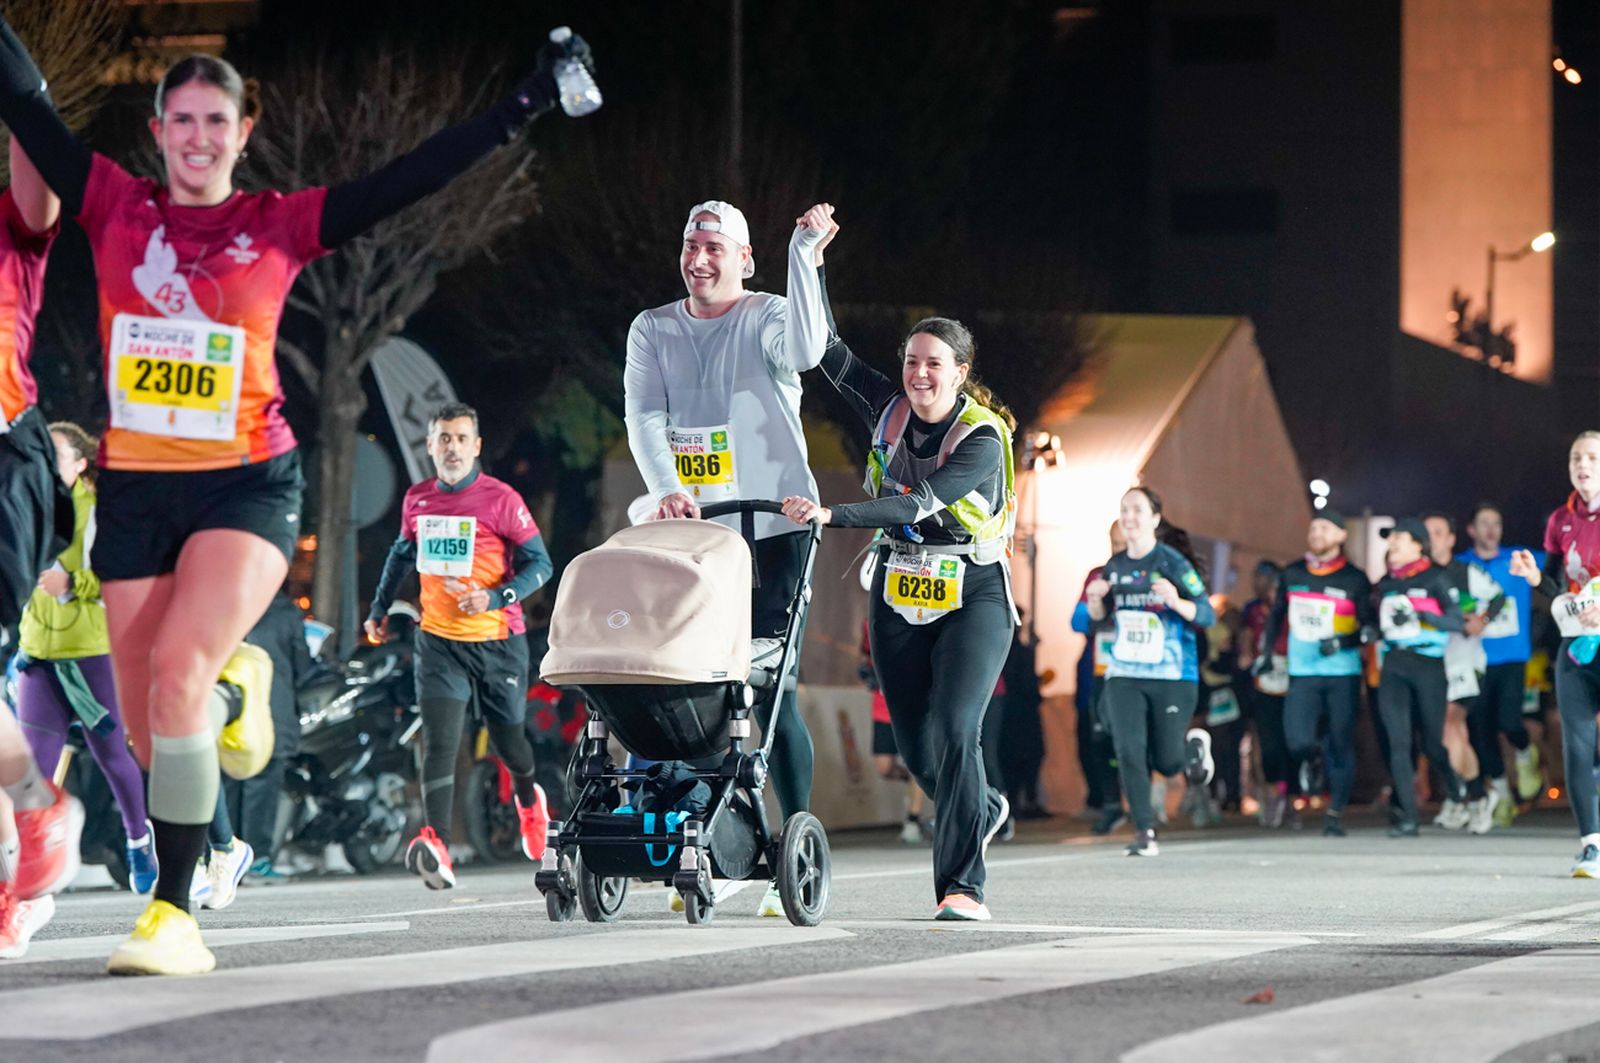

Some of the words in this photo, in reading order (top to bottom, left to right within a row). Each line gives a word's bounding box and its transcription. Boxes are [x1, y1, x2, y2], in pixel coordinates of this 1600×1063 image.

[154, 282, 186, 314] 43
[128, 342, 151, 354] SAN
[134, 359, 216, 397] 2306
[693, 436, 704, 444] DE
[427, 538, 468, 556] 12159
[923, 560, 933, 568] DE
[898, 575, 946, 601] 6238
